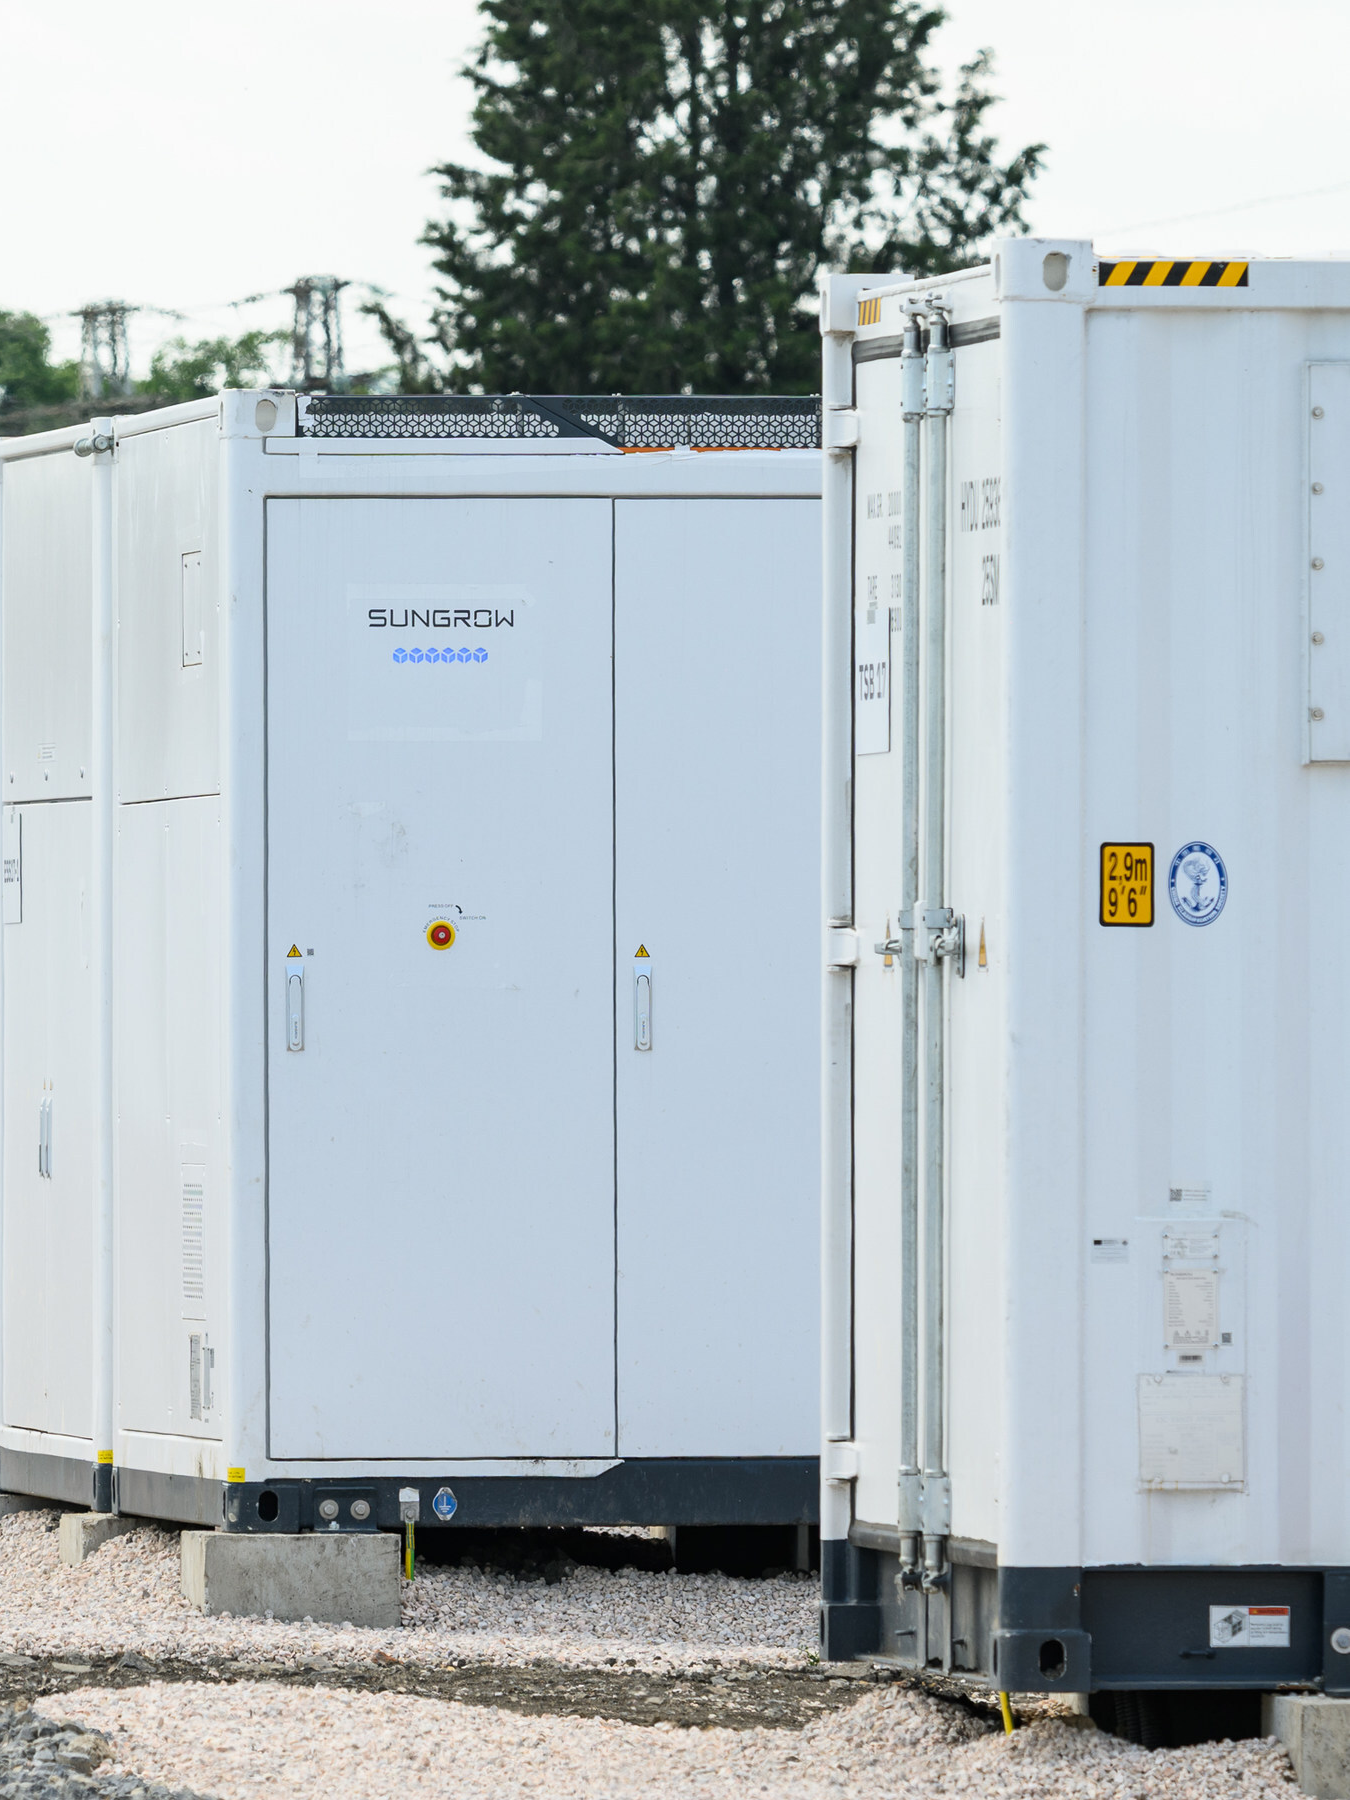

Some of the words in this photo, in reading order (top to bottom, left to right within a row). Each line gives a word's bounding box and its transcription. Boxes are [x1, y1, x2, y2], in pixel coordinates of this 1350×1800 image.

[368, 609, 514, 628] SUNGROW
[859, 664, 874, 701] TSB
[876, 662, 886, 699] 17
